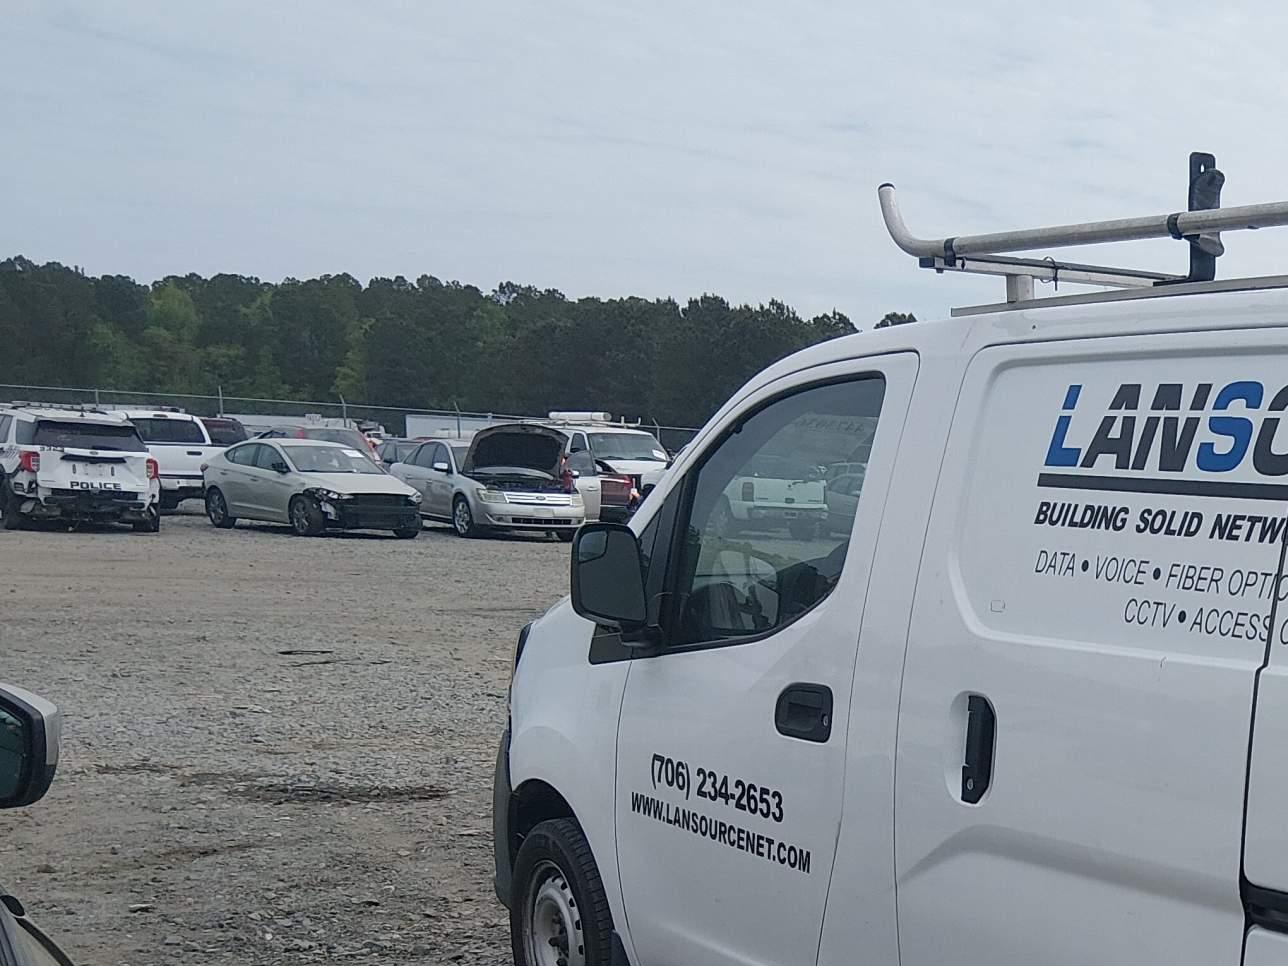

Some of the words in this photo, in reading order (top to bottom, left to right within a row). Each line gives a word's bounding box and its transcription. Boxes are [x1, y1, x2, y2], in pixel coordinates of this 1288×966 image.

[69, 481, 122, 490] POLICE
[1034, 502, 1129, 532] BUILDING
[1135, 508, 1203, 537] SOLID
[1035, 550, 1077, 578] DATA
[1094, 555, 1148, 585] VOICE
[1166, 562, 1225, 593] FIBER
[1124, 598, 1176, 629] CCTV
[1190, 606, 1272, 642] ACCESS
[651, 753, 690, 800] (706)
[696, 768, 784, 823] 234-2653
[631, 791, 811, 874] WWW.LANSOURCENET.COM
